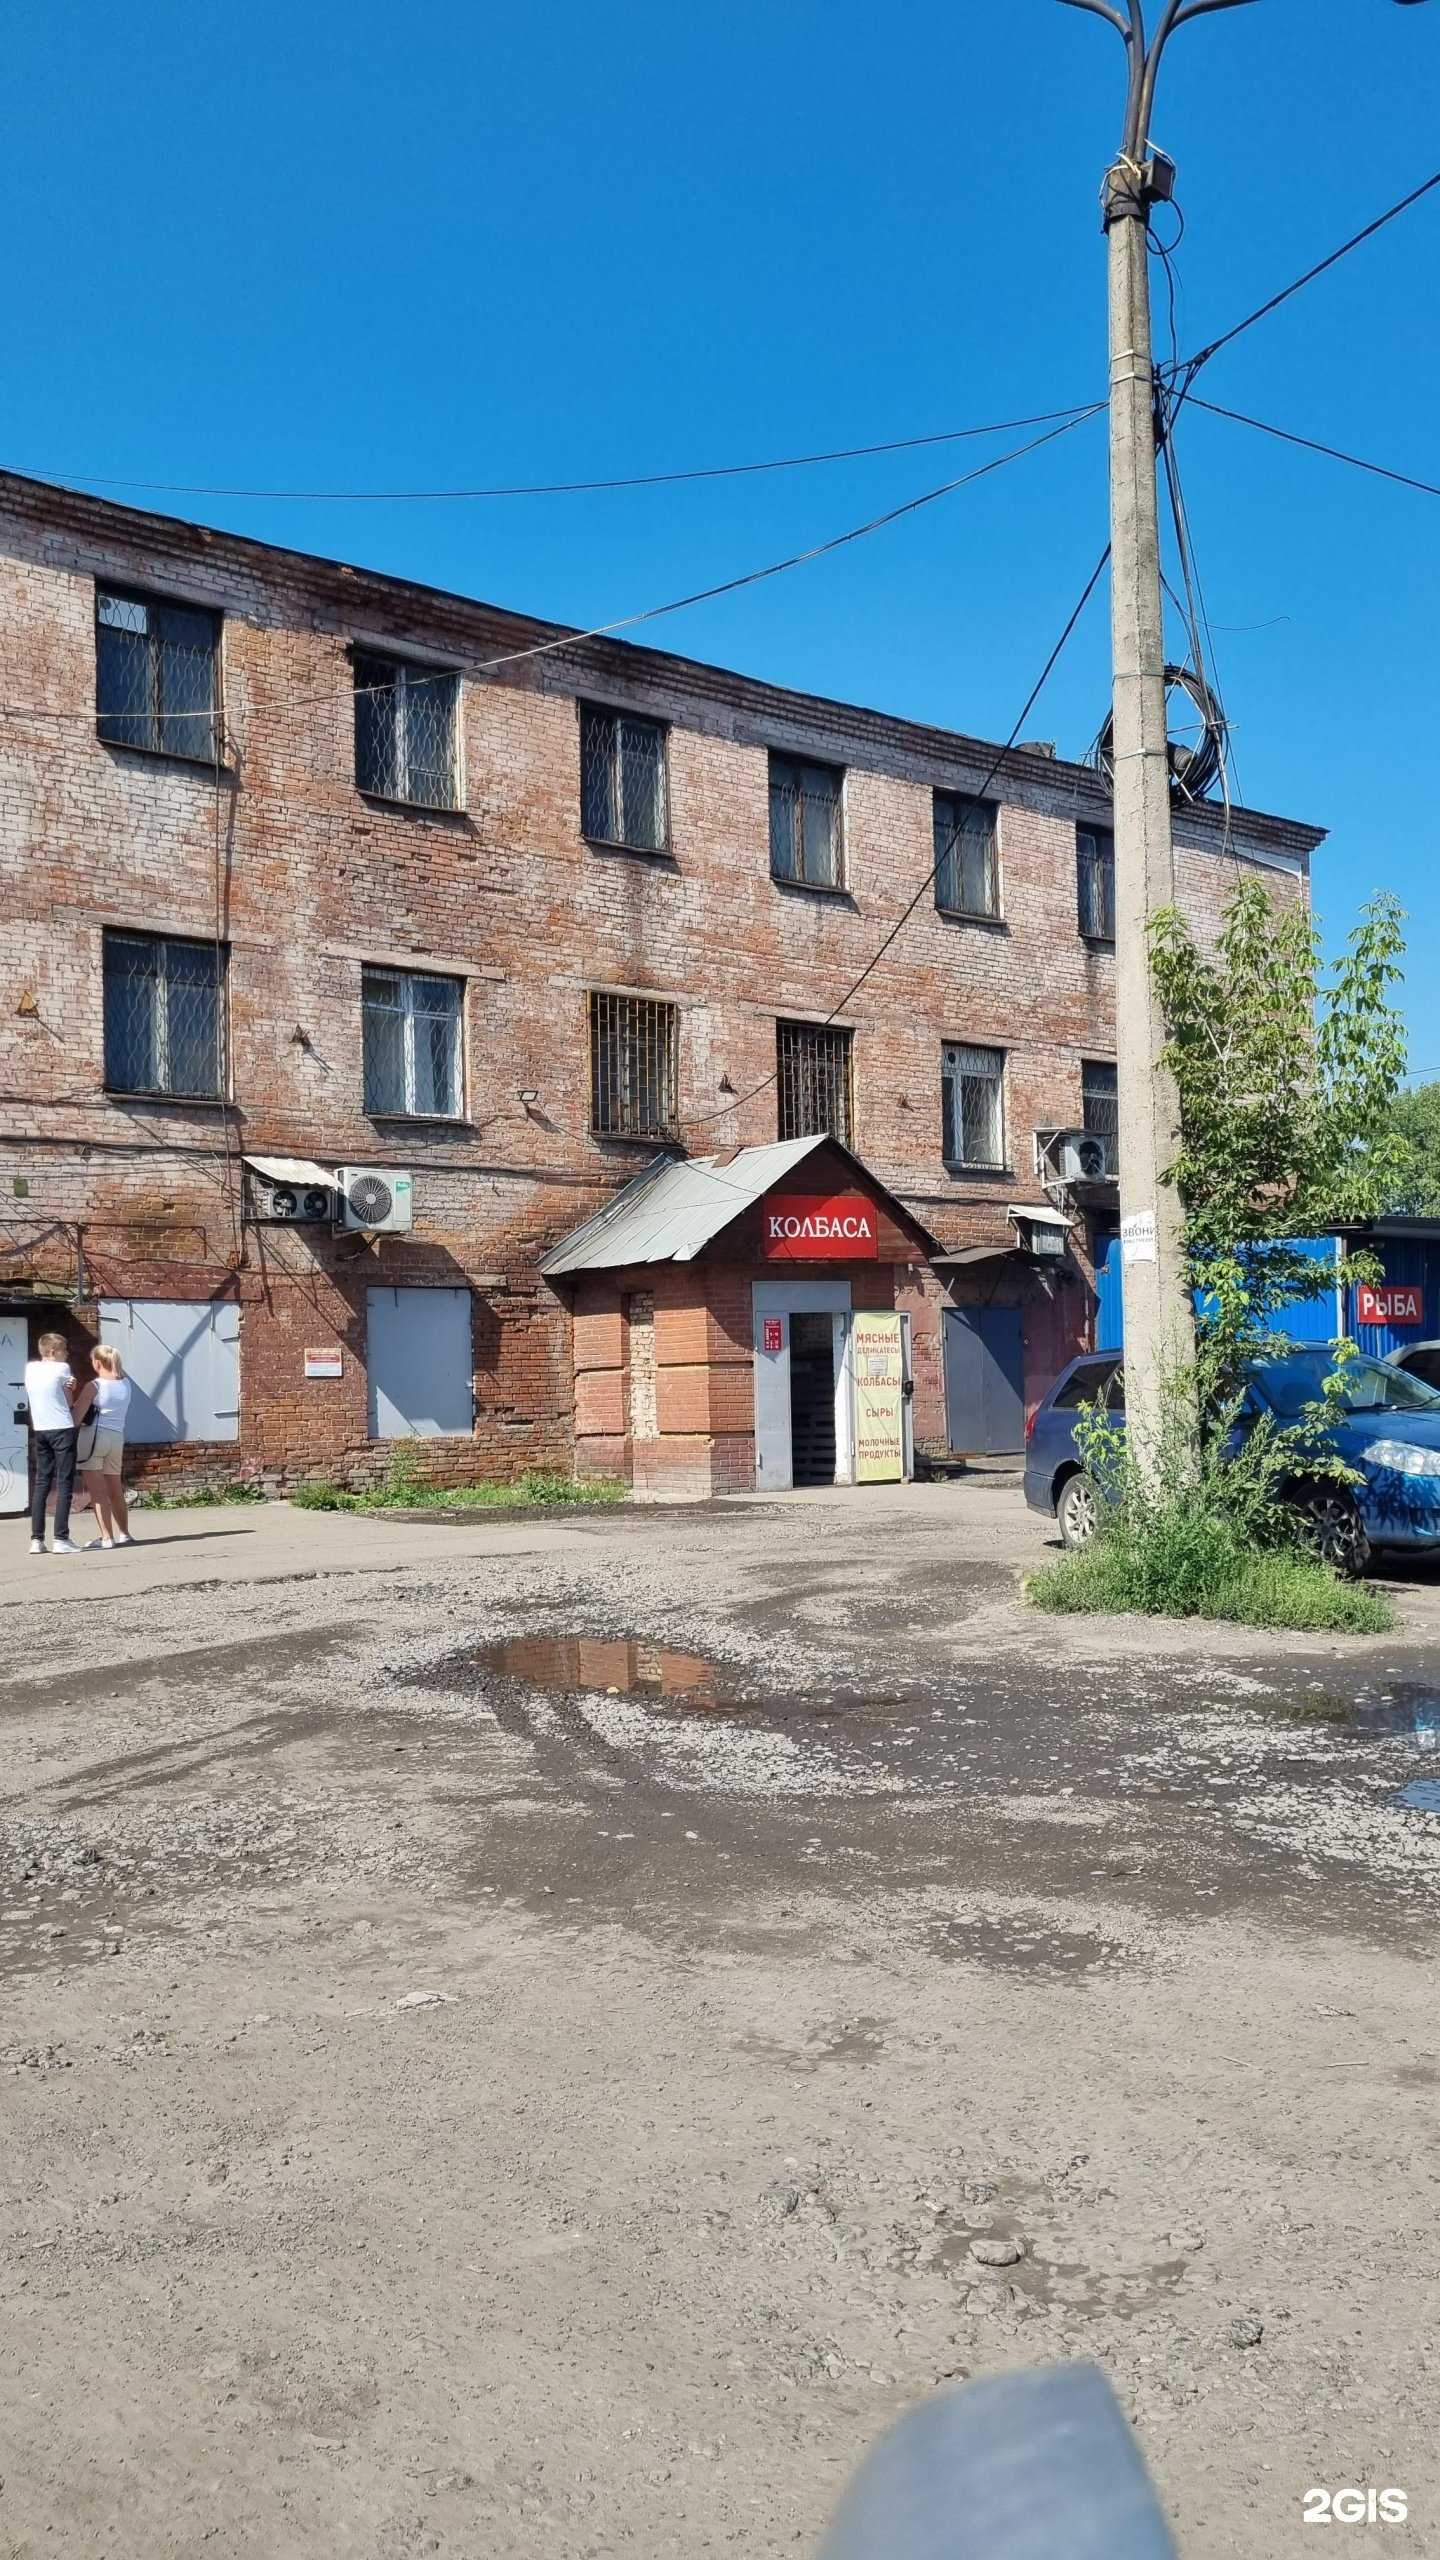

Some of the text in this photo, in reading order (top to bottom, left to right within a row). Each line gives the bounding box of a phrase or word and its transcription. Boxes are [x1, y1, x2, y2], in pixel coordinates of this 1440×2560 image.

[768, 1216, 872, 1238] КОЛБАСА
[1363, 1293, 1417, 1316] РЫБА
[856, 1332, 900, 1344] МЯСНЫЕ
[857, 1376, 901, 1387] КОЛБАСЫ
[866, 1407, 894, 1418] СЫРЫ
[858, 1437, 900, 1448] МОЛОЧНЫЕ
[858, 1449, 901, 1461] ПРОДУКТЫ
